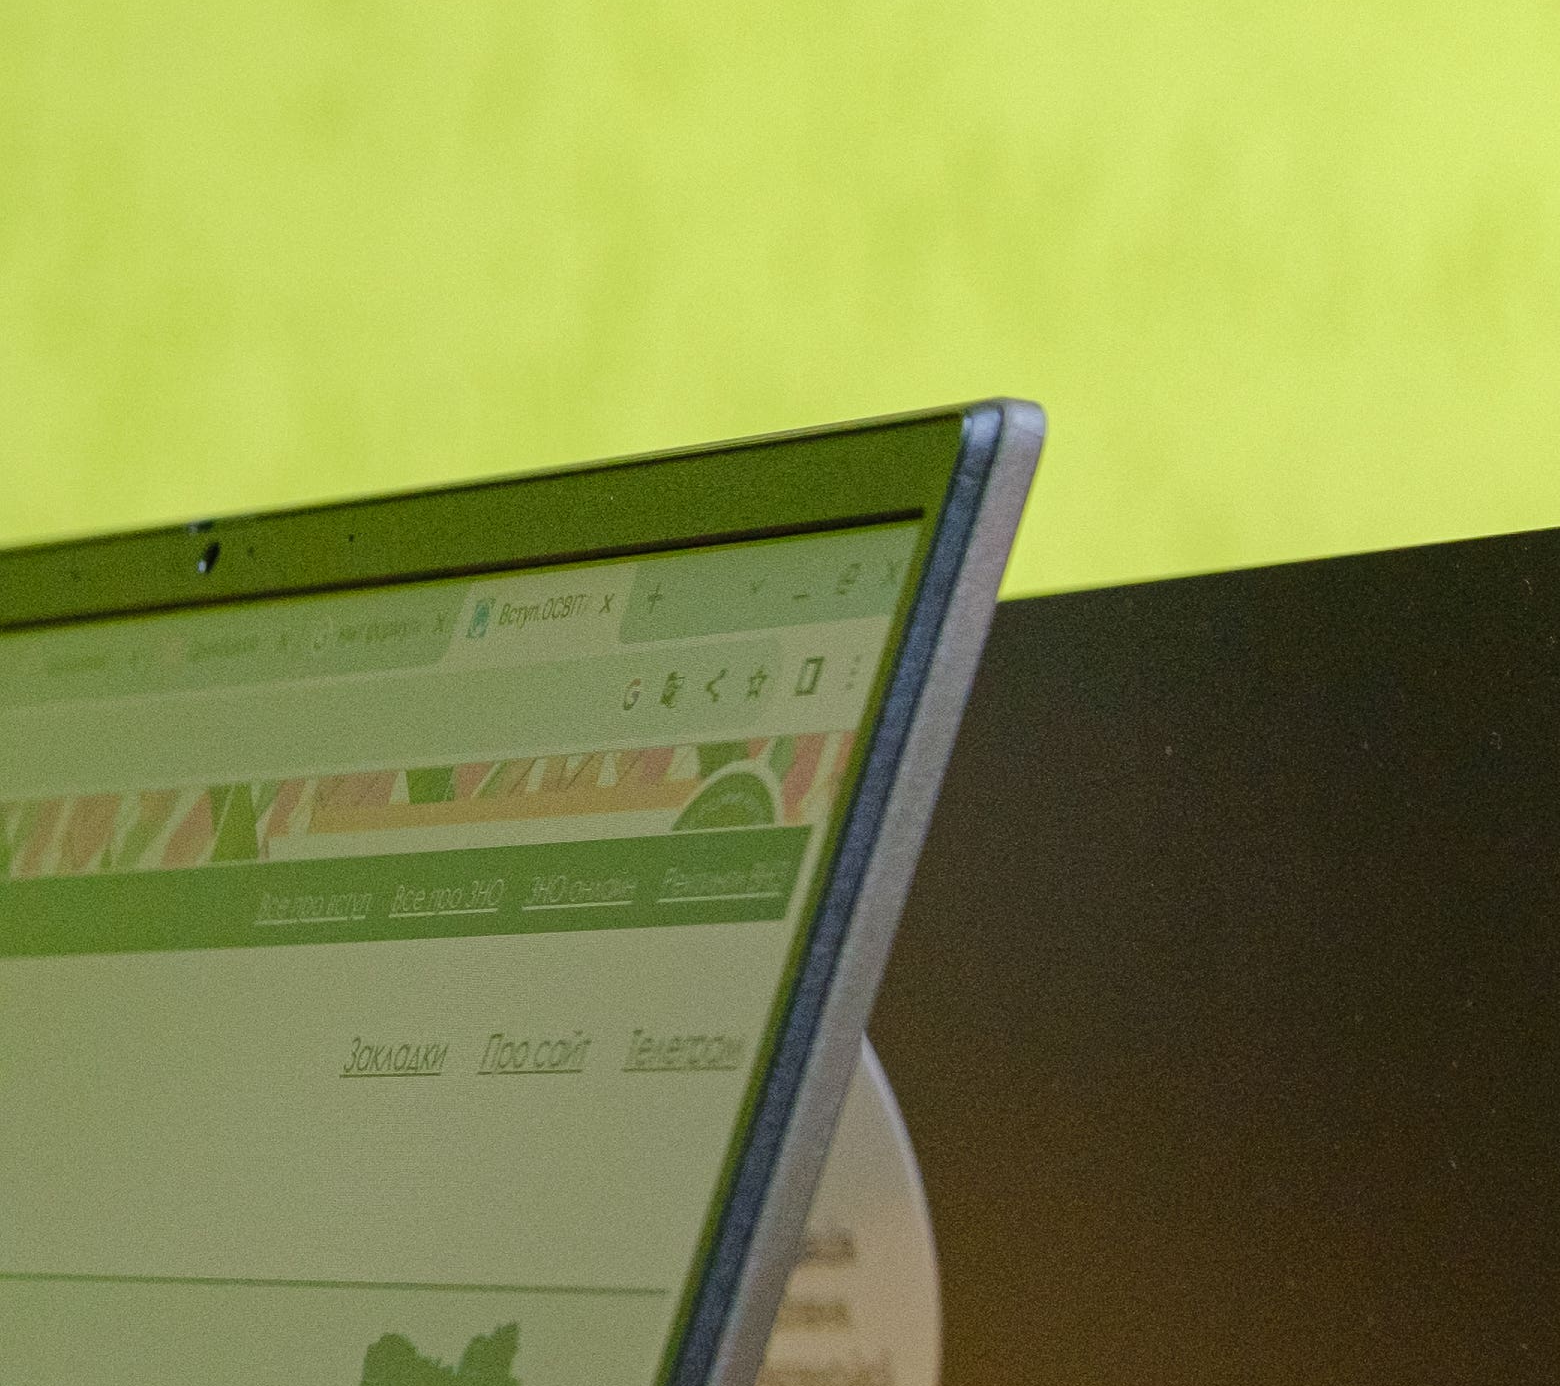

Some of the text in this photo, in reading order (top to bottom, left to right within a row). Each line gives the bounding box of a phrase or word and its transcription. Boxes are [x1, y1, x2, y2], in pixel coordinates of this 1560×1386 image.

[391, 878, 504, 914] Все про ЗНО
[525, 876, 566, 902] ЗНО
[341, 1036, 449, 1076] Закладки
[479, 1030, 592, 1076] Про сайт
[622, 1028, 745, 1073] Телеграм
